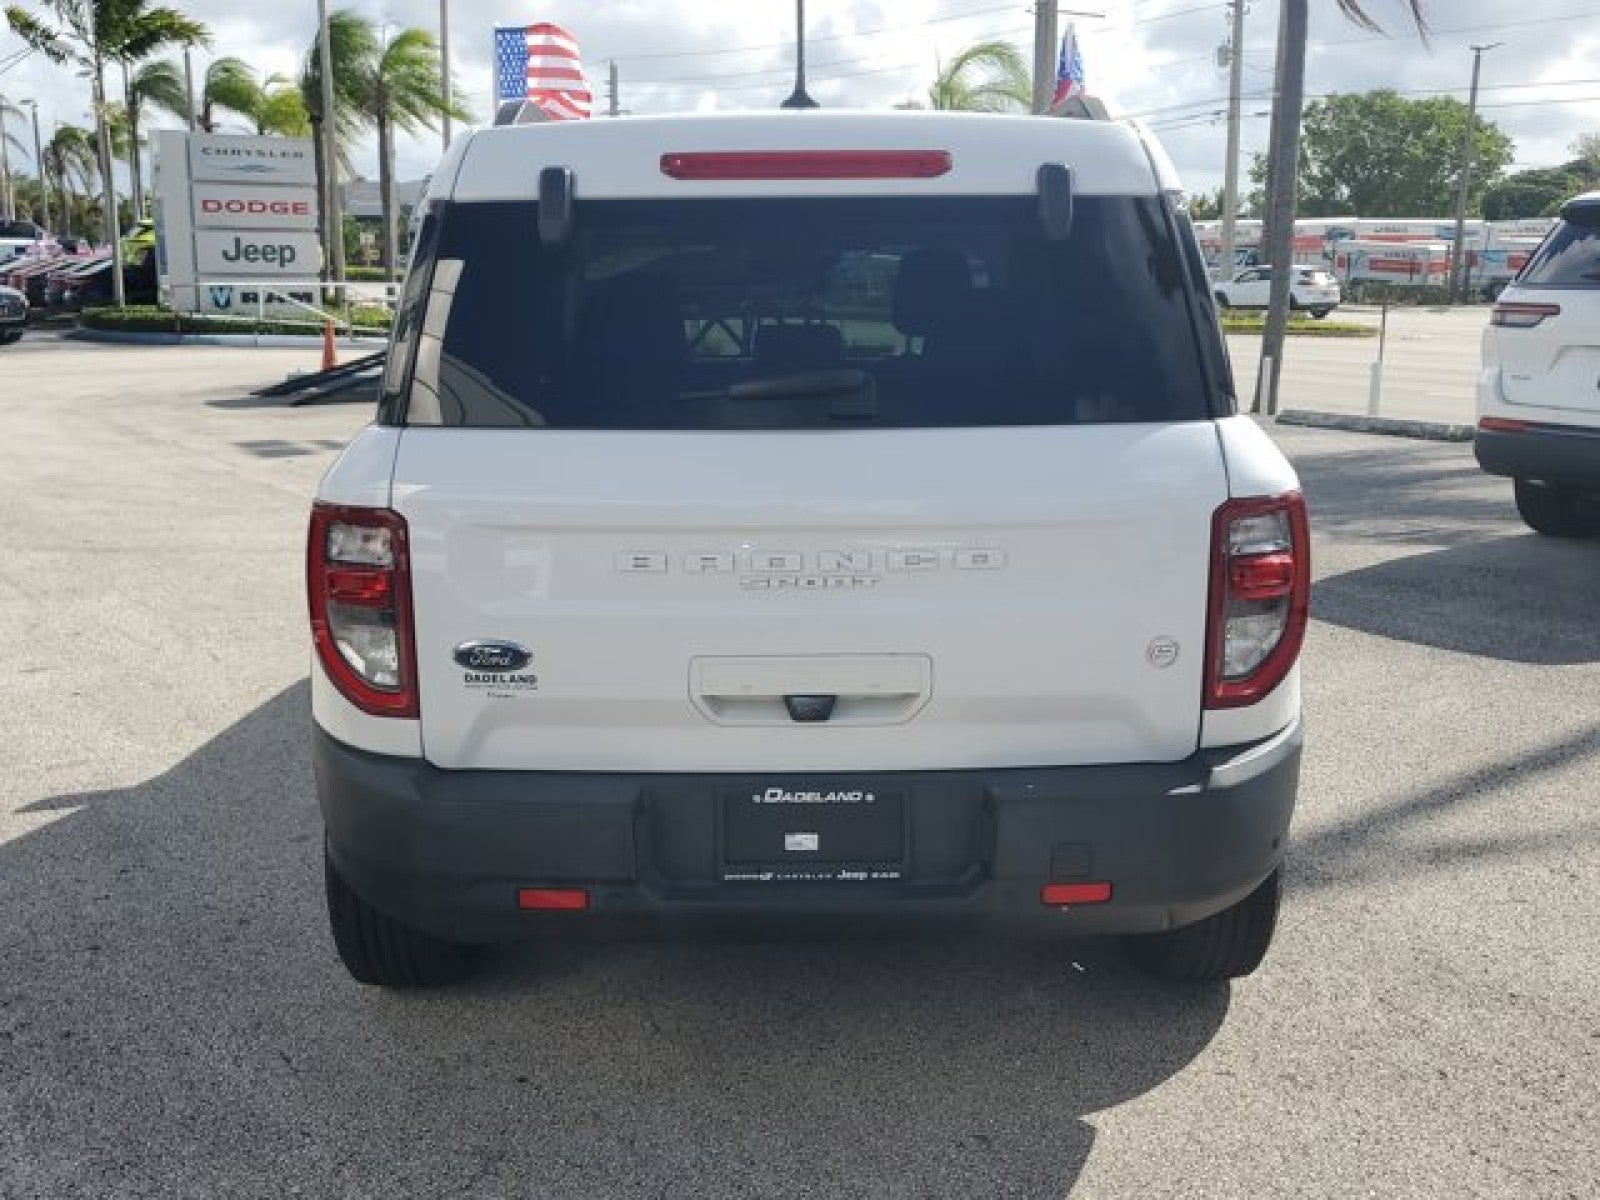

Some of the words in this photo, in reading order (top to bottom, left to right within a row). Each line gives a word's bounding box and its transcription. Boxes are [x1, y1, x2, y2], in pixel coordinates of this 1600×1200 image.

[202, 199, 309, 215] DODGE
[222, 237, 296, 268] Jeep
[240, 291, 313, 303] RAM
[616, 549, 1008, 574] BRONCO
[740, 575, 881, 591] SPORT
[468, 647, 513, 667] Ford
[464, 674, 538, 684] DADELAND
[764, 787, 864, 803] DADELAND
